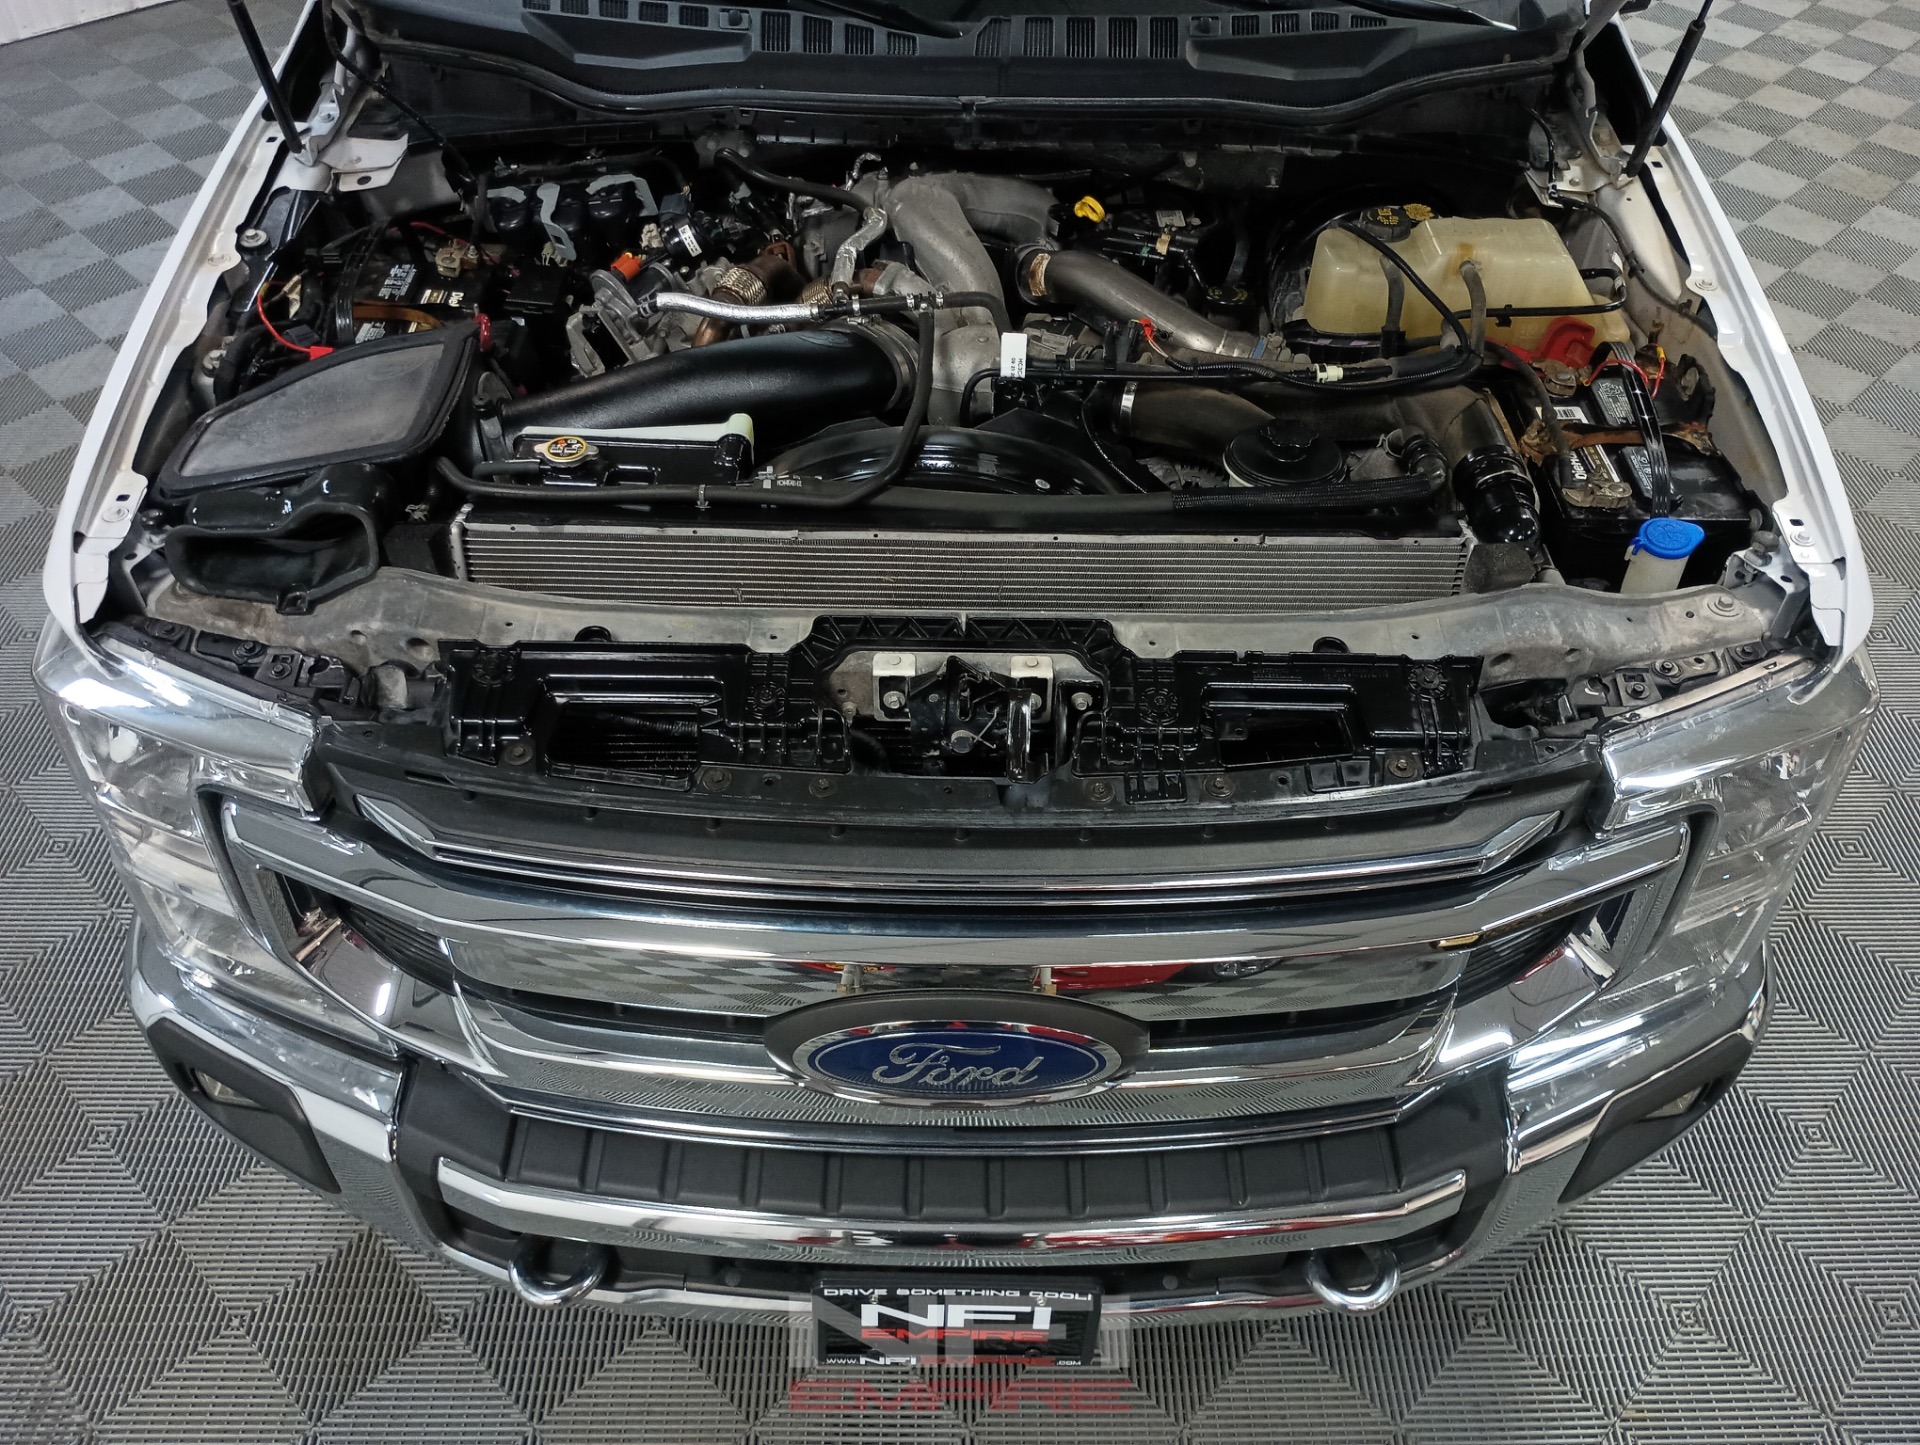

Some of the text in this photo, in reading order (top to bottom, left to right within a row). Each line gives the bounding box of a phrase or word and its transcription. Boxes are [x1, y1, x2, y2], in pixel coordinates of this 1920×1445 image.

[872, 1042, 1045, 1087] Ford
[824, 1288, 1093, 1301] DRIVE SOMETHING COOL!
[861, 1303, 1052, 1330] NFI
[861, 1328, 1049, 1342] EMPIRE
